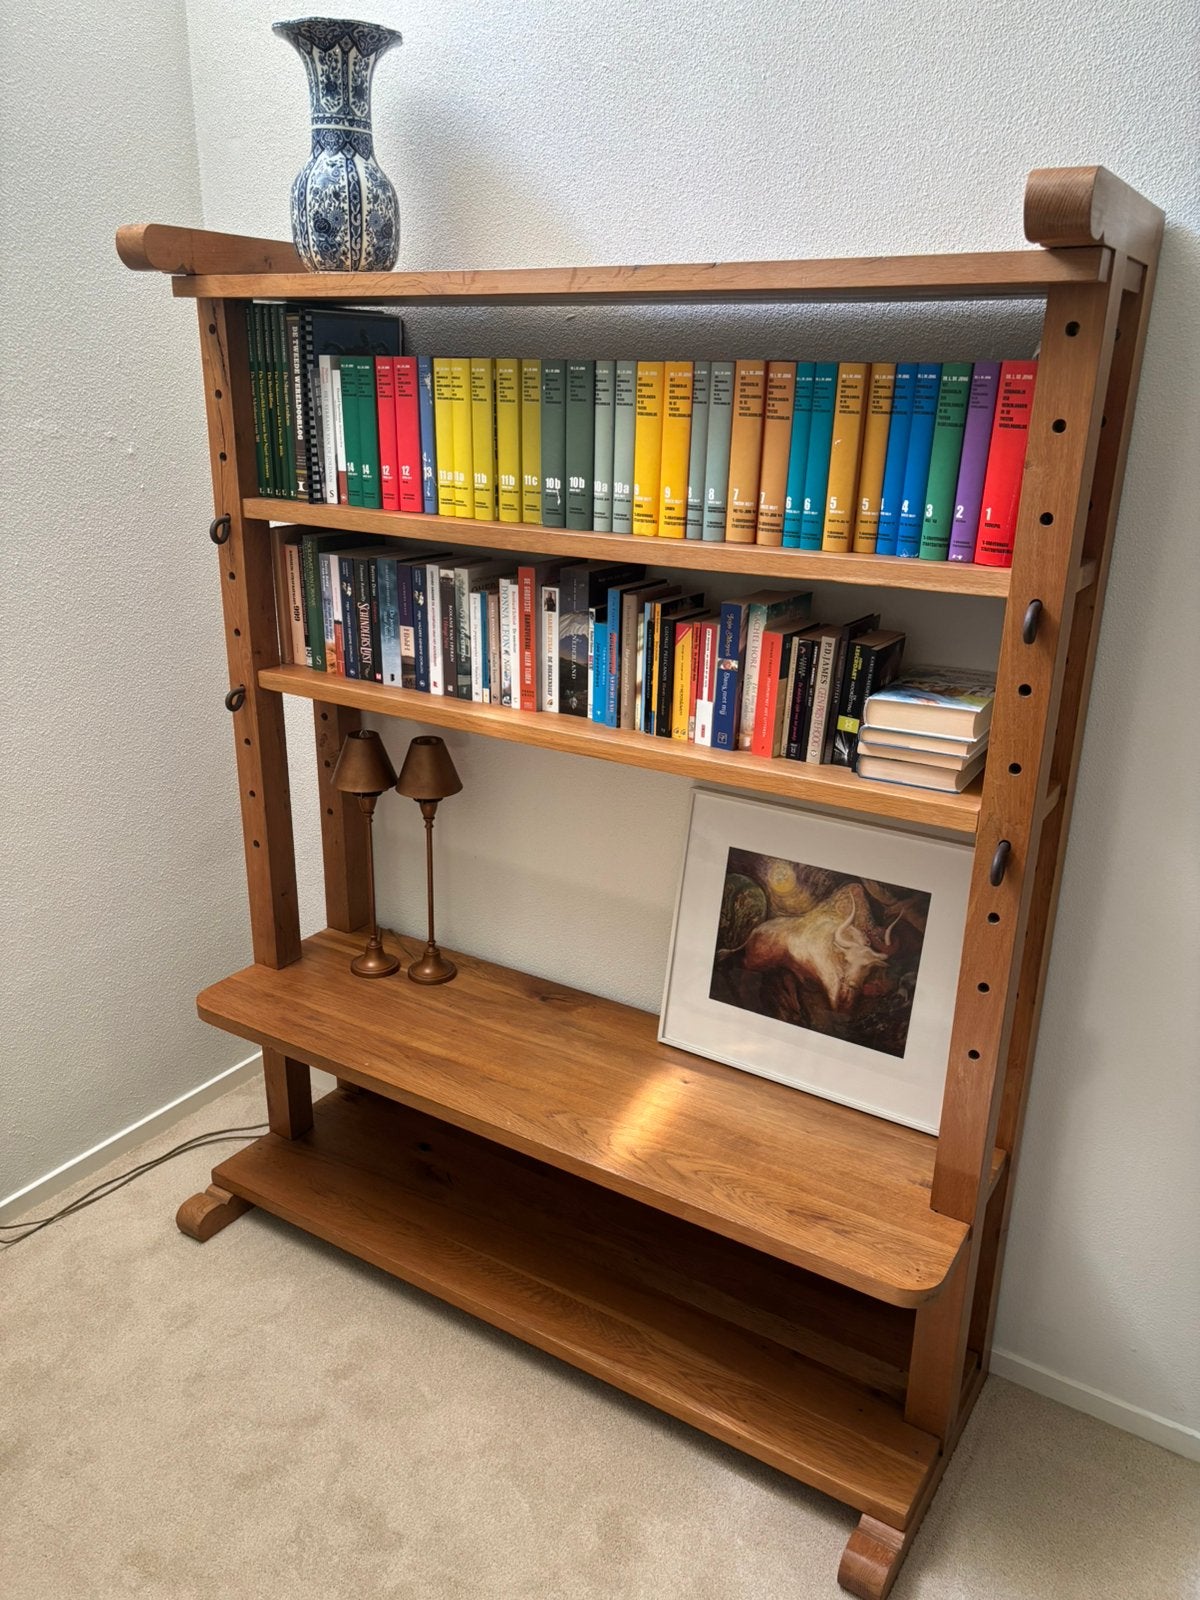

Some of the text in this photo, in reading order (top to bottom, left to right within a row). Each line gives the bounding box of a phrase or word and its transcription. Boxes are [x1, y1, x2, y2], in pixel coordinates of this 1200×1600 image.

[292, 326, 304, 441] DE TWEEDE WERELDOORLOG
[347, 462, 354, 472] 14
[362, 464, 370, 474] 14
[382, 465, 390, 476] 12
[401, 465, 410, 476] 12
[474, 473, 487, 484] 11b
[501, 474, 515, 486] 11b
[524, 475, 538, 486] 11c
[545, 477, 561, 490] 10b
[569, 476, 585, 489] 10b
[614, 481, 630, 494] 10a
[708, 487, 715, 500] 8
[733, 488, 739, 501] 7
[760, 492, 766, 504] 7
[785, 496, 792, 509] 6
[804, 497, 811, 511] 6
[829, 496, 838, 509] 5
[861, 497, 870, 511] 5
[901, 499, 909, 513] 4
[925, 503, 933, 518] 3
[955, 505, 964, 519] 2
[985, 507, 992, 521] 1
[501, 585, 510, 649] DONNA LEON
[749, 645, 760, 670] HORE
[851, 645, 861, 681] LESCROART
